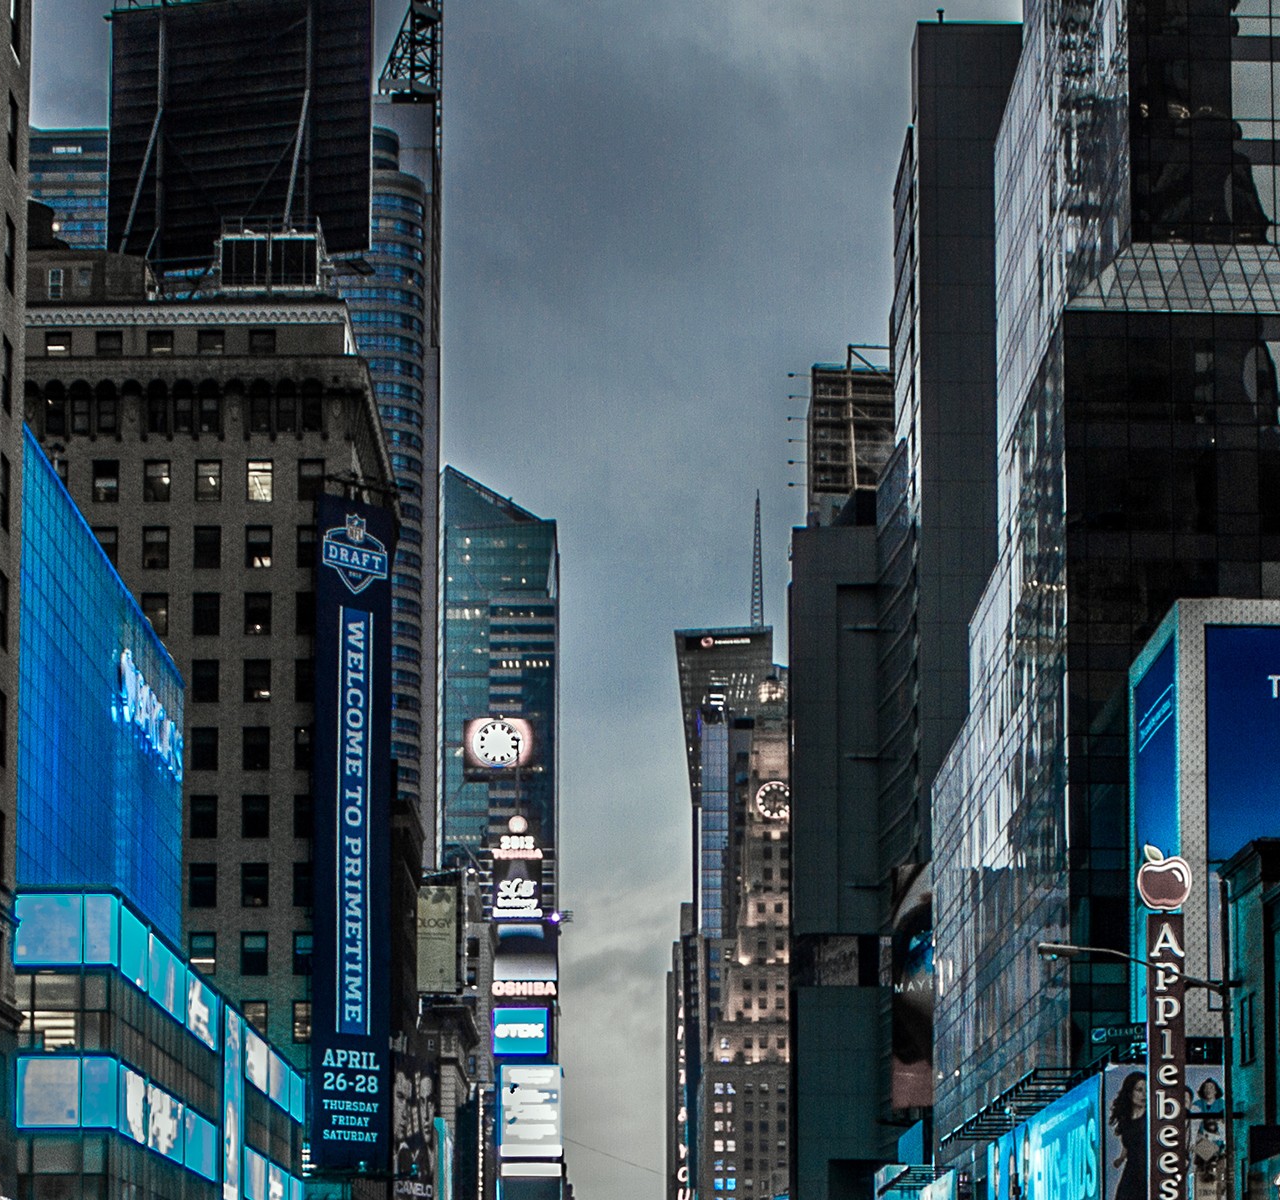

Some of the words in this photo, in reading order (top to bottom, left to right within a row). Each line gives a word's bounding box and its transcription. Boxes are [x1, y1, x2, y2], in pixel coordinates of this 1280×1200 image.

[328, 544, 382, 570] DRAFT
[343, 620, 365, 778] WELCOME
[344, 785, 363, 828] TO
[343, 836, 362, 1023] PRIMETIME
[322, 1048, 380, 1071] APRIL
[322, 1072, 380, 1094] 26-28
[322, 1098, 380, 1114] THURSDAY
[331, 1115, 370, 1128] FRIDAY
[322, 1129, 379, 1143] SATURDAY
